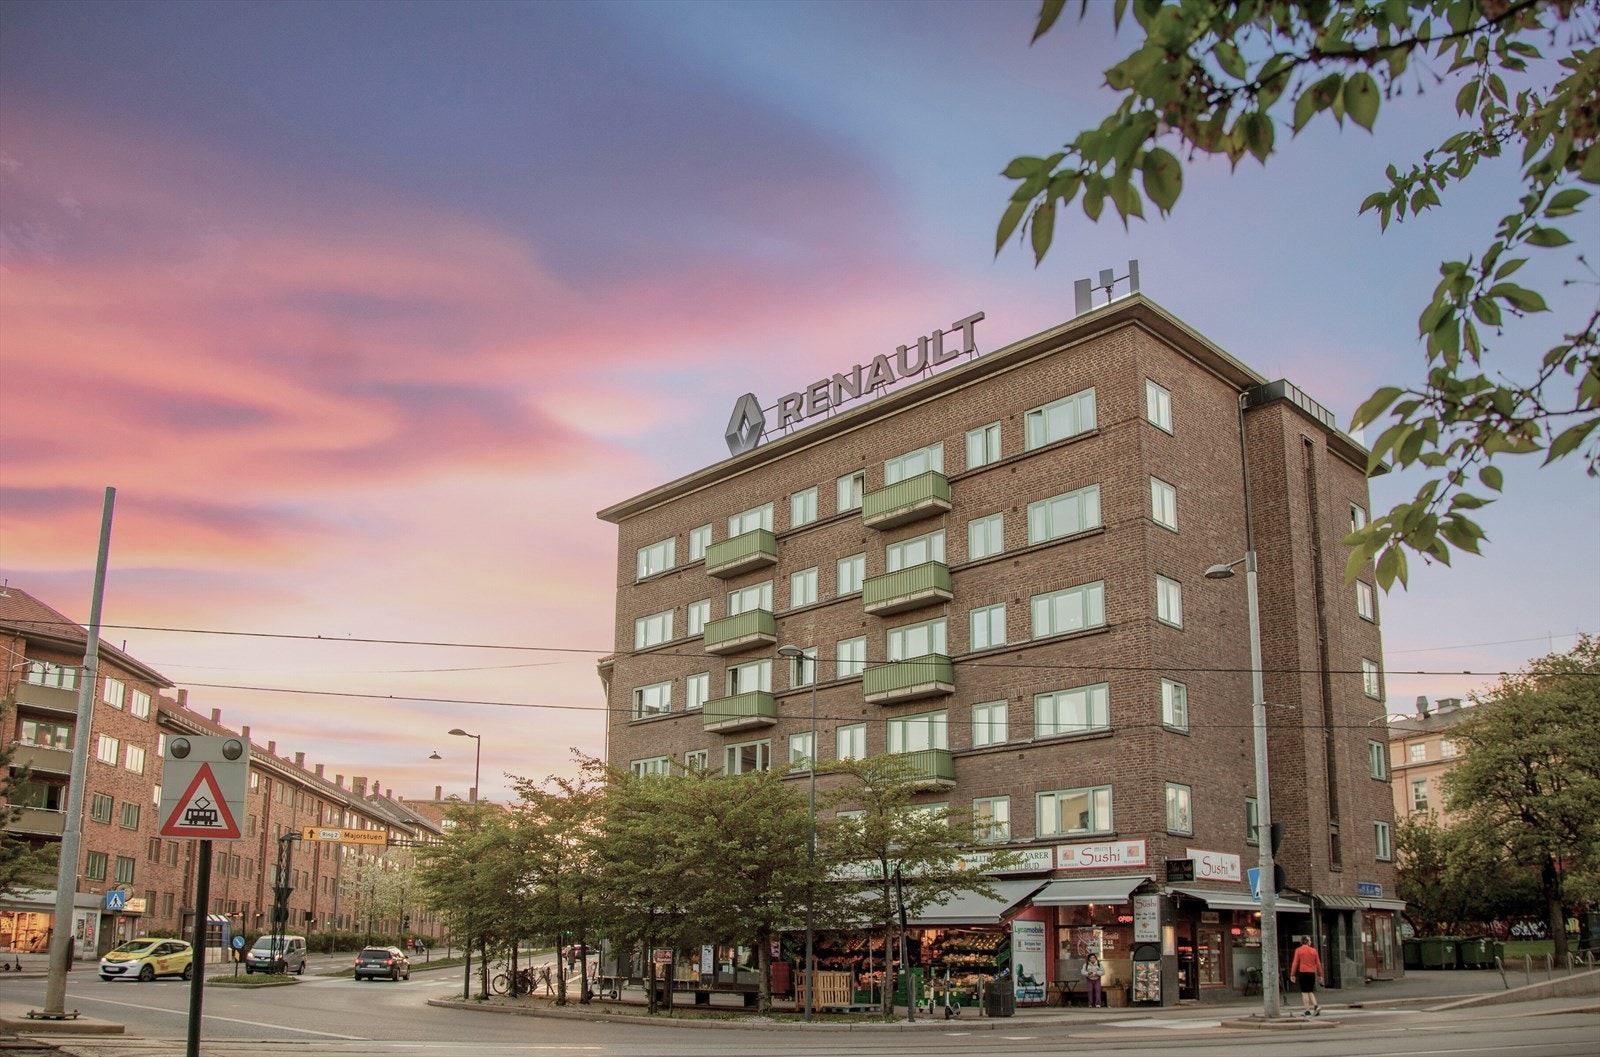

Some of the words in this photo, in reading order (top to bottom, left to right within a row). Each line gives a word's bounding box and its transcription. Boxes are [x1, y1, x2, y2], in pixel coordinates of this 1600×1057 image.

[777, 311, 985, 428] RENAULT
[344, 832, 383, 841] Majorstuen
[1025, 851, 1049, 860] VARER
[1080, 846, 1120, 866] Sushi
[1014, 862, 1040, 871] TILBUD
[1202, 856, 1229, 876] Sushi
[1135, 899, 1157, 909] Sushi
[1014, 926, 1044, 934] Lycamobile
